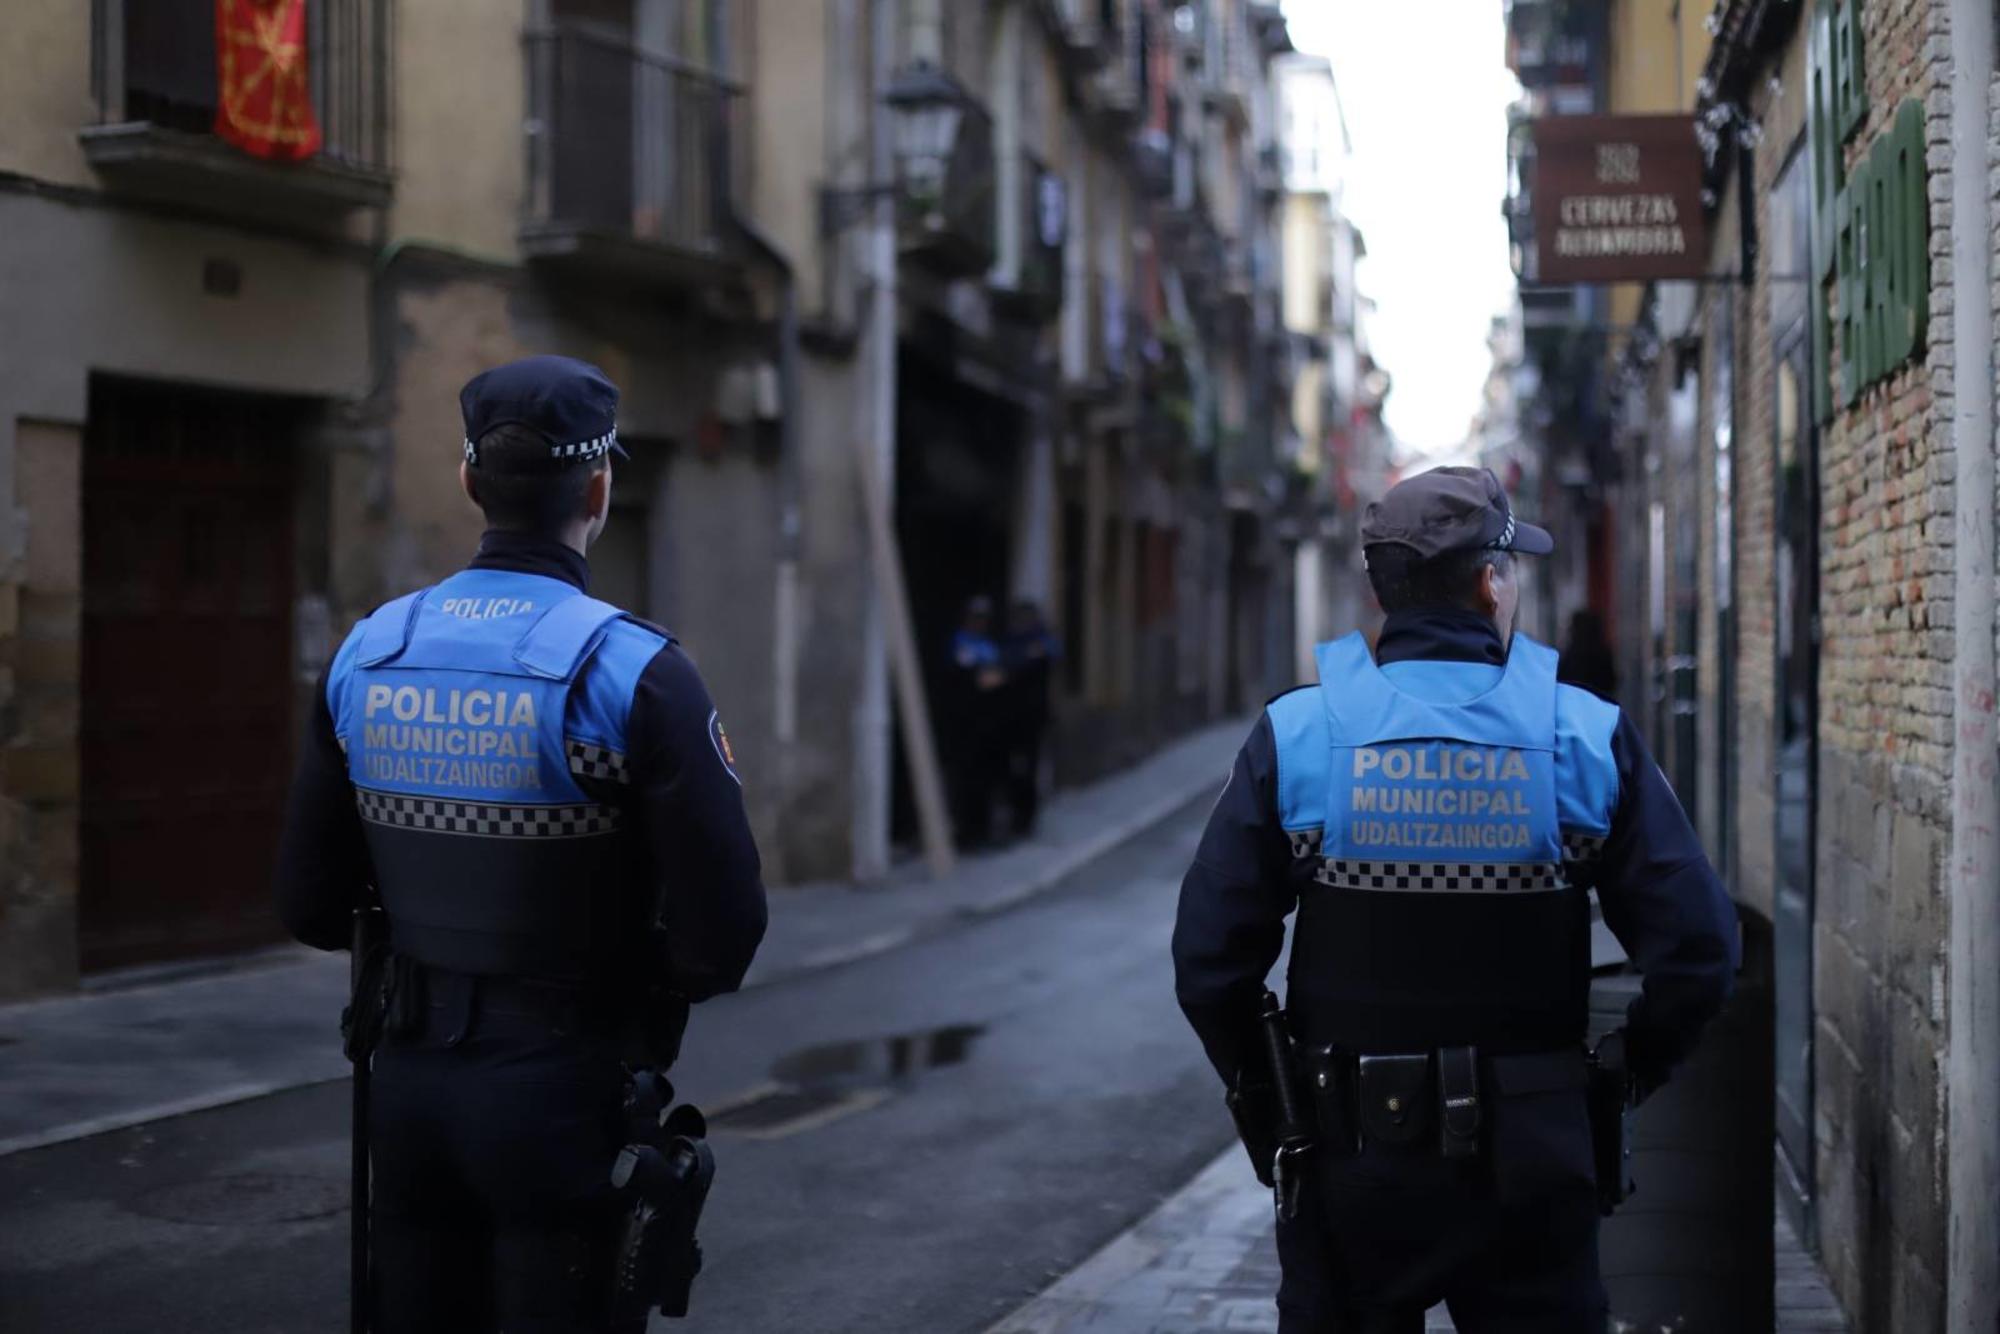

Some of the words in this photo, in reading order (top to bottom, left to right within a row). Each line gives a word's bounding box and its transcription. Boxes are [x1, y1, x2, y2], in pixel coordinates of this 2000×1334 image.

[1560, 195, 1678, 225] CERVEZAS
[443, 598, 534, 619] POLICIA
[365, 684, 536, 727] POLICIA
[364, 724, 539, 759] MUNICIPAL
[364, 755, 541, 790] UDALTZAINGOA
[1353, 748, 1530, 781] POLICIA
[1352, 786, 1531, 815] MUNICIPAL
[1352, 820, 1532, 848] UDALTZAINGOA
